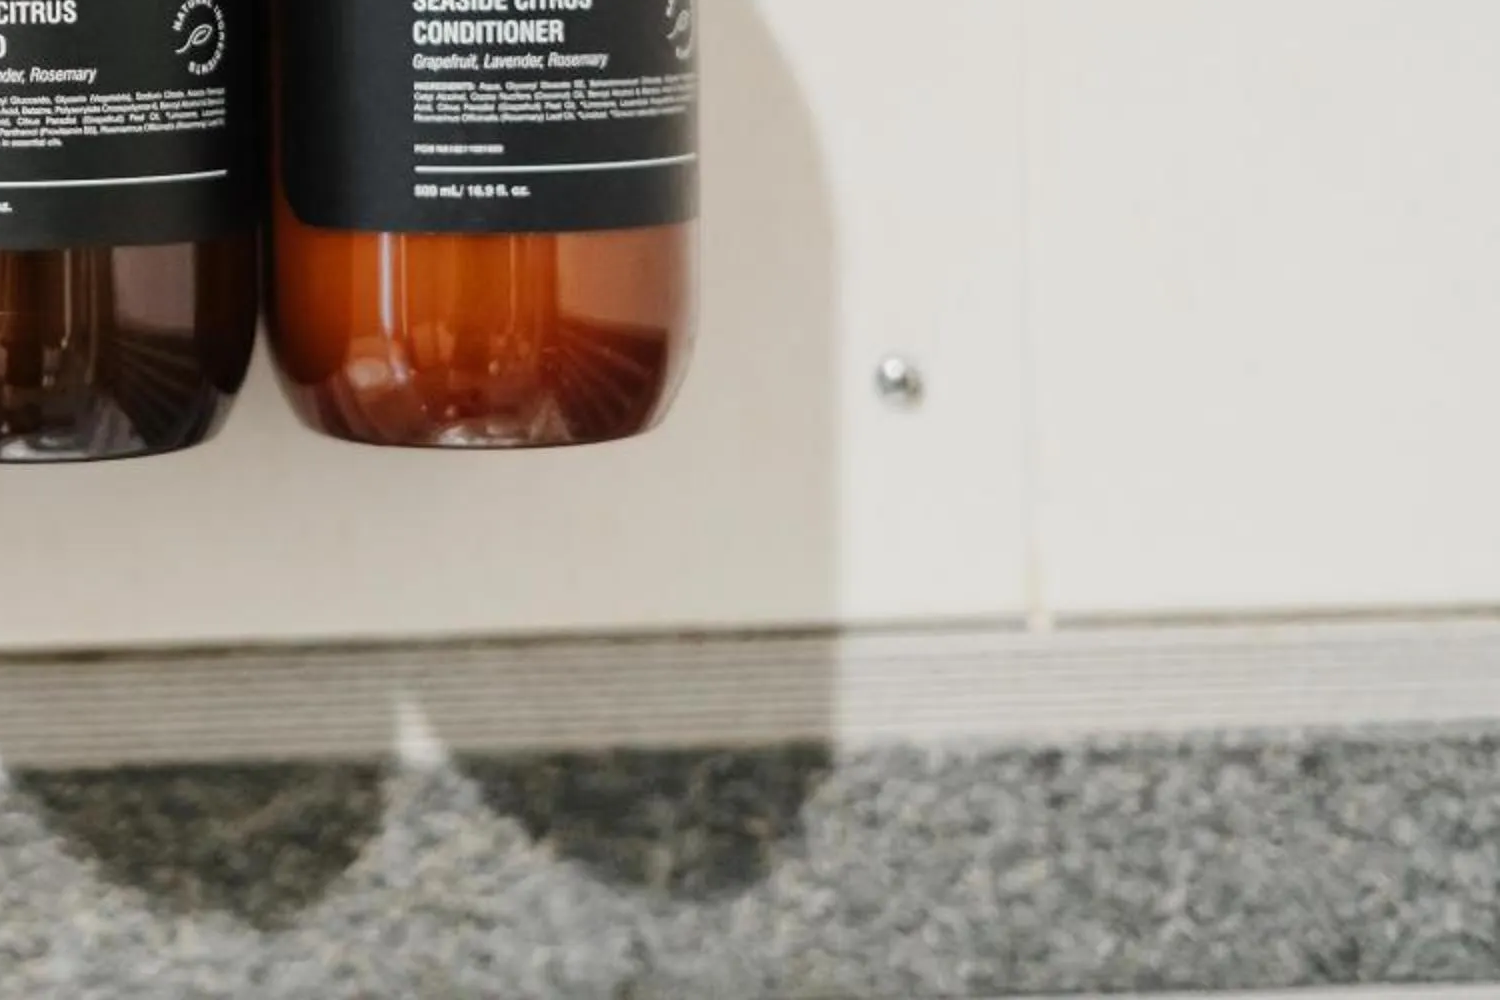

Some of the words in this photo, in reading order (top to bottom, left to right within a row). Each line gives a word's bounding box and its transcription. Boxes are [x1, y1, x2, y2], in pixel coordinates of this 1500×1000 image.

[412, 19, 565, 45] CONDITIONER
[412, 53, 479, 72] Grapefruit,
[483, 52, 544, 70] Lavender,
[547, 51, 609, 70] Rosemary
[29, 66, 98, 84] Rosemary
